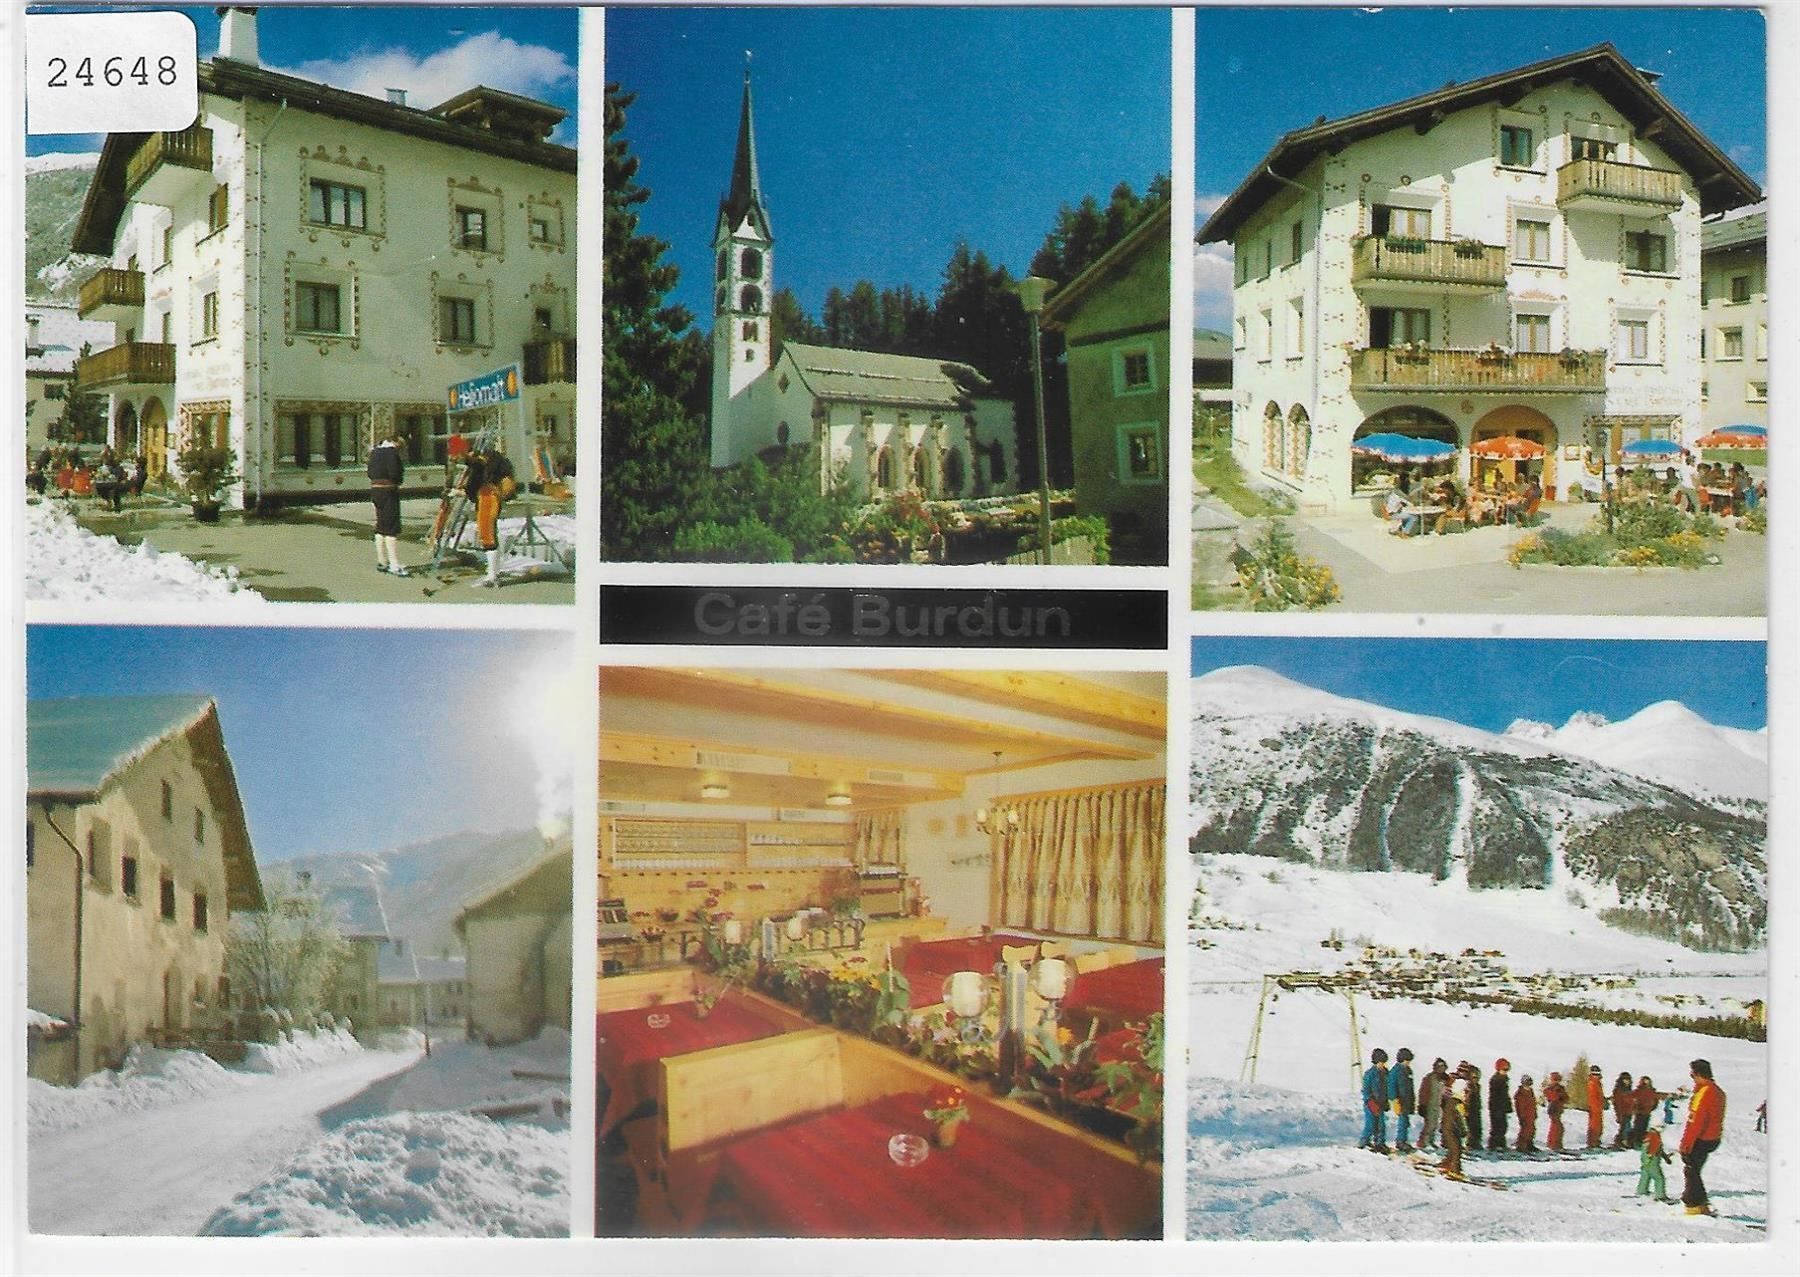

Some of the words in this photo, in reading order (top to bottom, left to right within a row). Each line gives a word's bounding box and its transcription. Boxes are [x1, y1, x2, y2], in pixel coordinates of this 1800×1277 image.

[48, 55, 178, 87] 24648
[693, 592, 832, 637] Café
[851, 592, 1072, 639] Burdun
